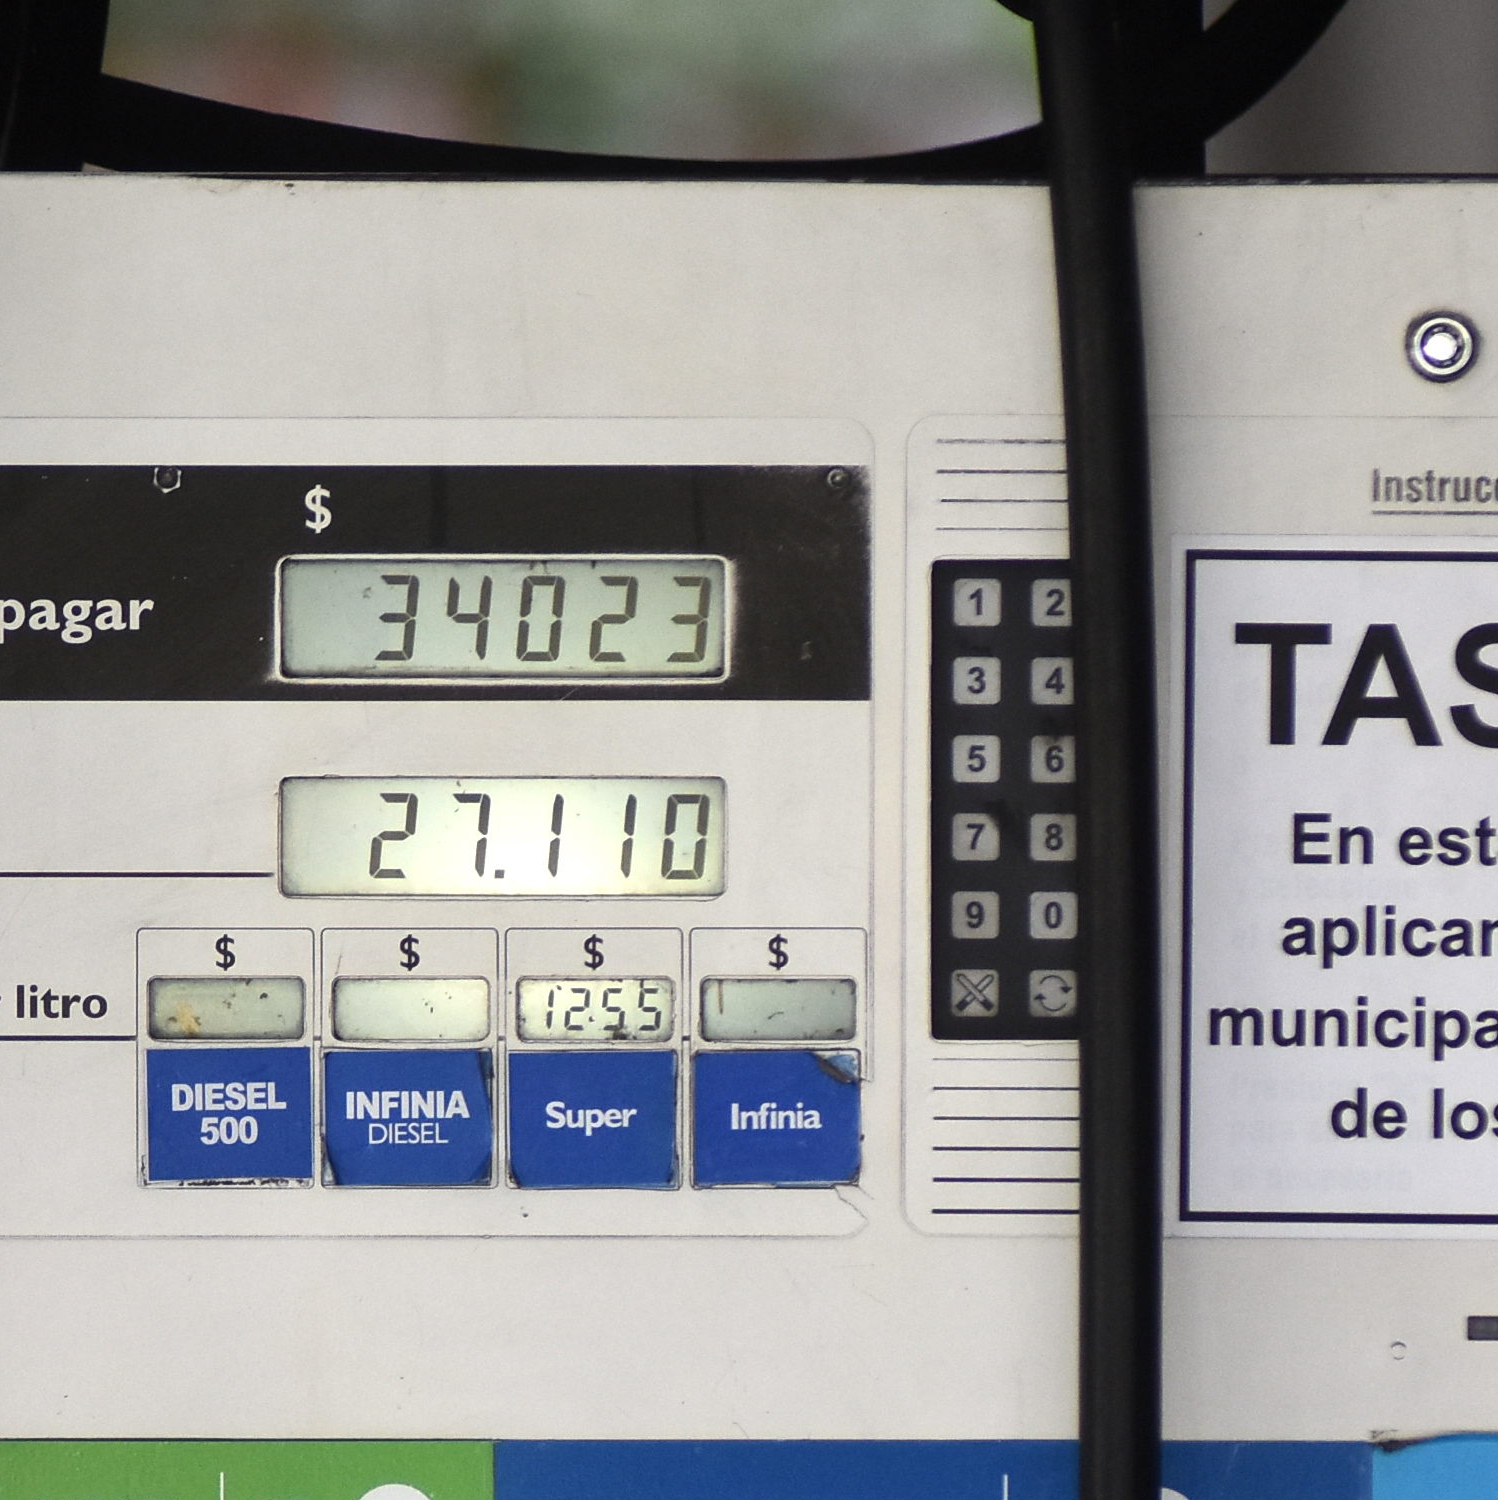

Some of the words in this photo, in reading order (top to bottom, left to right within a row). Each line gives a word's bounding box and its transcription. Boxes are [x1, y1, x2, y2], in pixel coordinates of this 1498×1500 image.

[304, 484, 333, 533] $
[969, 588, 984, 616] 1
[1046, 588, 1065, 617] 2
[374, 574, 712, 662] 34023
[967, 666, 986, 695] 3
[1045, 666, 1064, 695] 4
[967, 744, 986, 773] 5
[1045, 744, 1064, 773] 6
[368, 793, 711, 880] 27.110
[966, 823, 986, 851] 7
[1044, 823, 1063, 852] 8
[1292, 812, 1375, 866] En
[965, 901, 985, 930] 9
[1043, 901, 1062, 930] 0
[214, 936, 237, 971] $
[399, 936, 422, 971] $
[583, 933, 605, 971] $
[767, 933, 789, 971] $
[15, 984, 109, 1020] litro
[171, 1082, 287, 1113] DIESEL
[345, 1090, 471, 1120] INFINIA
[545, 1100, 637, 1137] Super
[730, 1102, 822, 1131] Infinia
[1330, 1086, 1409, 1140] de
[200, 1117, 258, 1146] 500
[368, 1123, 450, 1146] DIESEL
